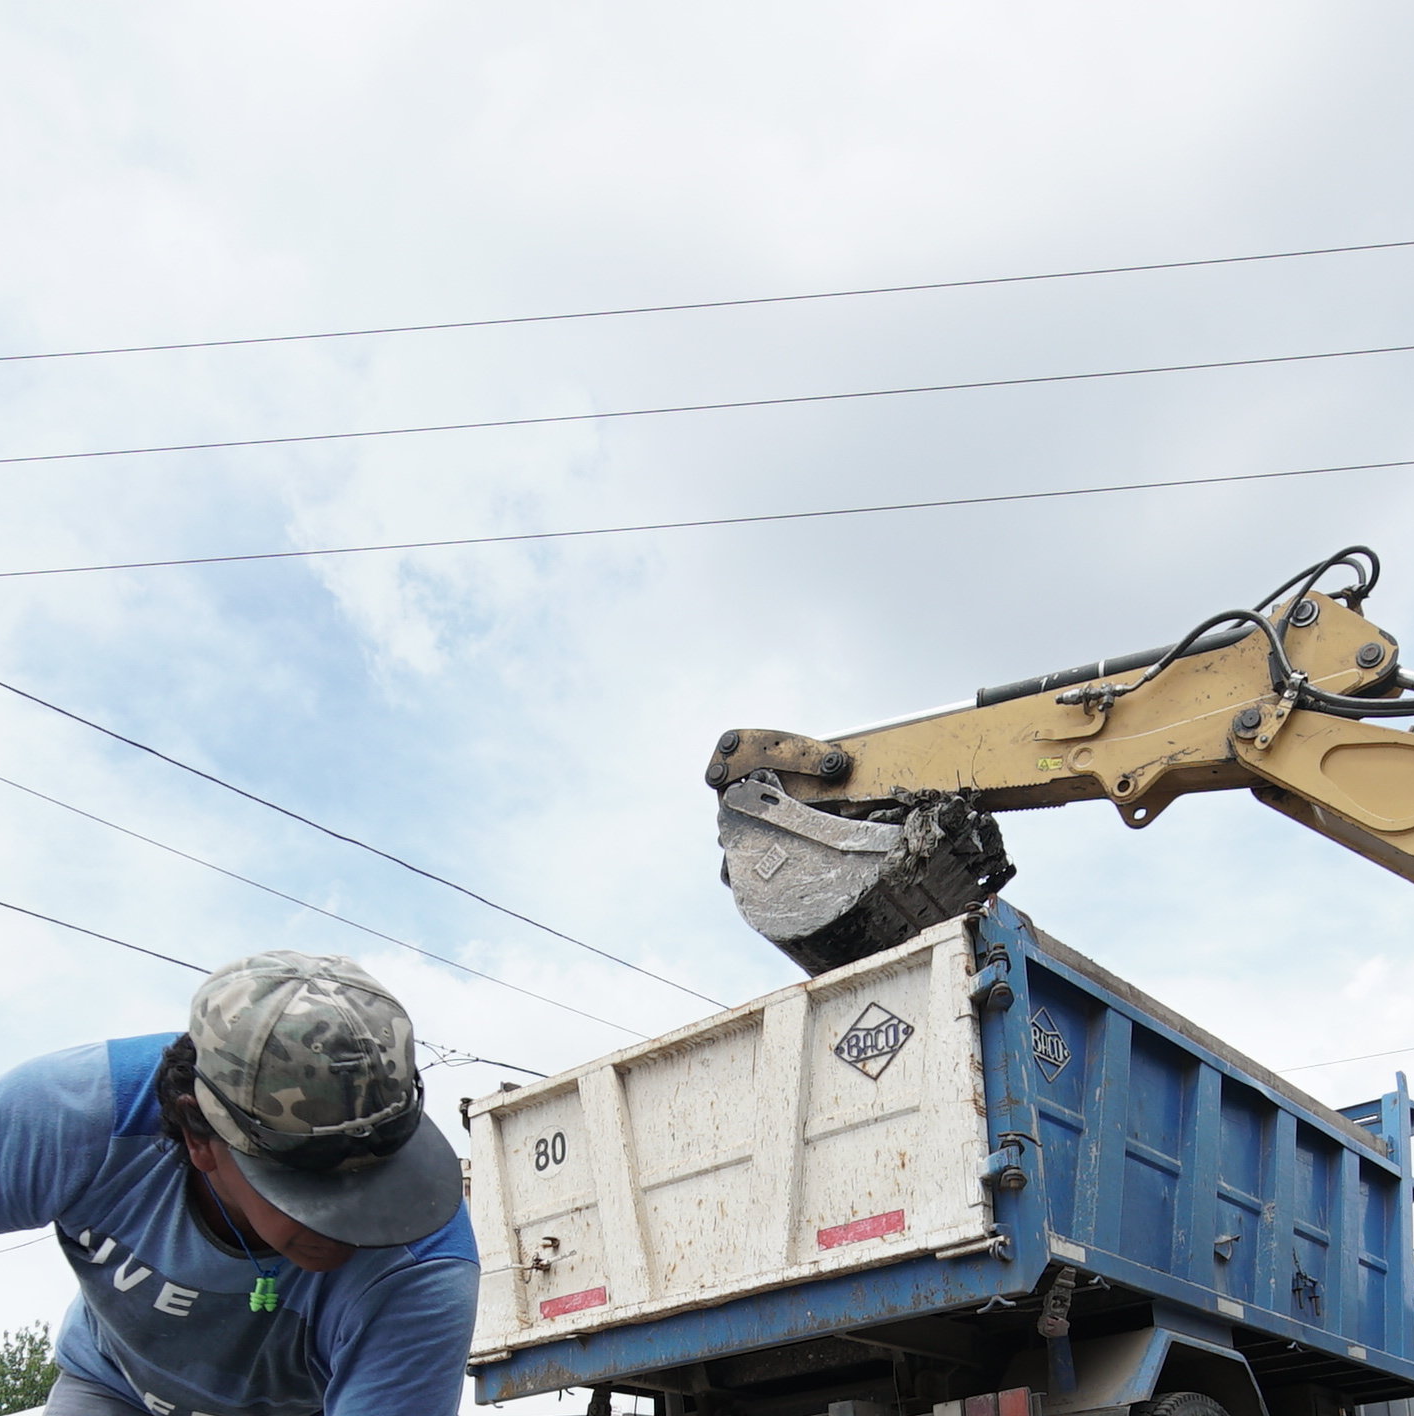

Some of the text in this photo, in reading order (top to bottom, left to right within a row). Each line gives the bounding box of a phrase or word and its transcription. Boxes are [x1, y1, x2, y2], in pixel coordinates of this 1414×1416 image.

[846, 1022, 900, 1059] BACO
[1031, 1026, 1065, 1063] BACO
[535, 1131, 566, 1172] 80
